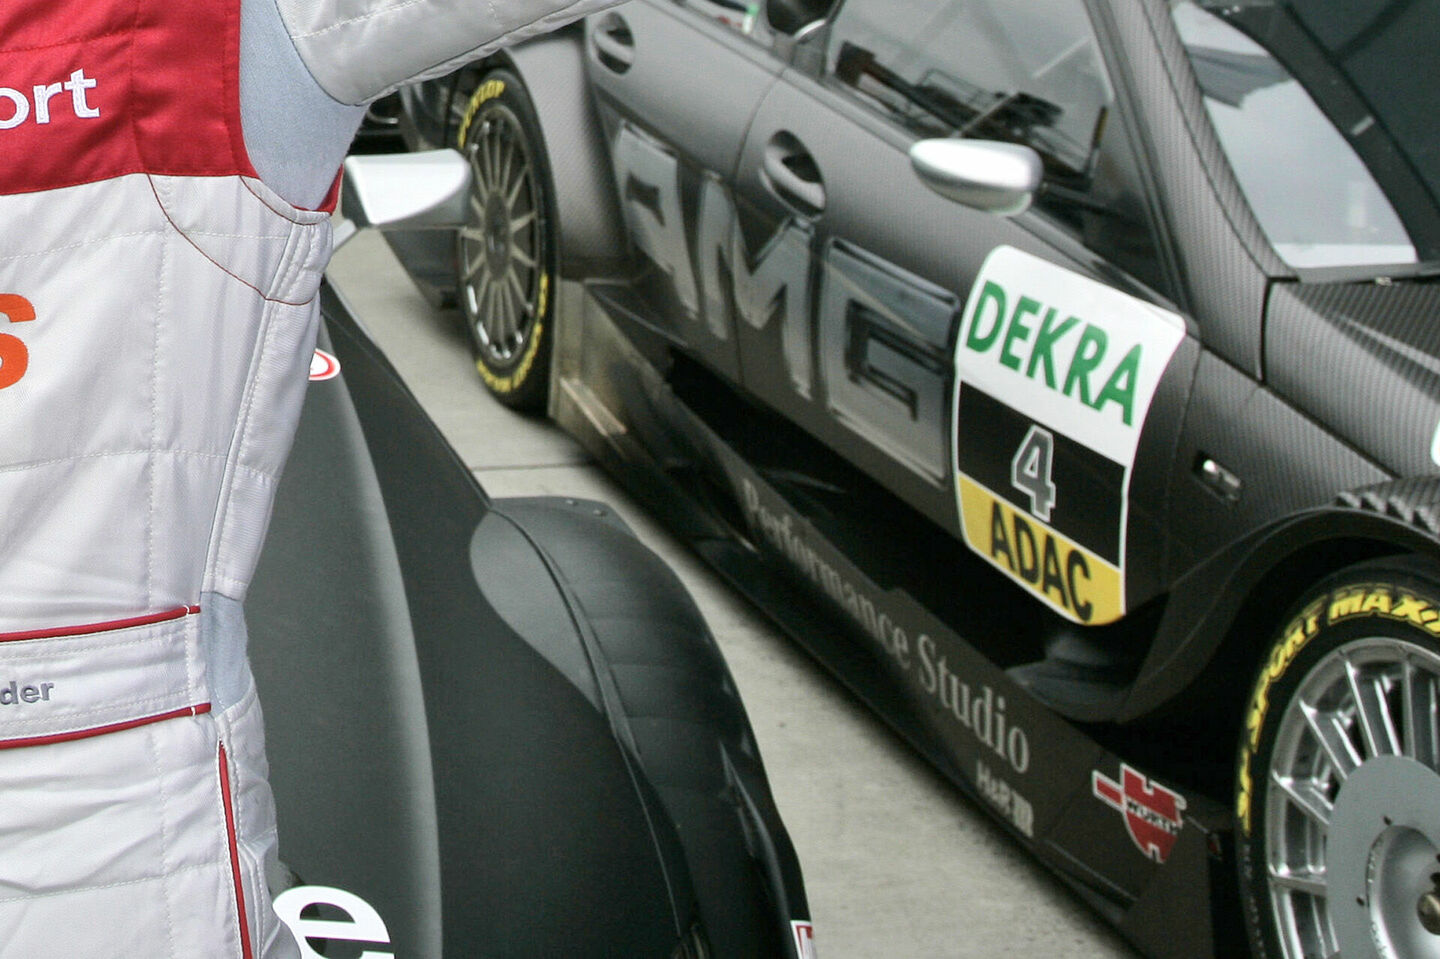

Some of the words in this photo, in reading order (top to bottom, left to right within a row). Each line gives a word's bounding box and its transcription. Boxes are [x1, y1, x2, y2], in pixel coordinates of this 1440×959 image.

[613, 118, 959, 491] AMG
[965, 280, 1143, 428] DEKRA
[1011, 424, 1057, 523] 4
[743, 477, 911, 670] Performance
[917, 633, 1030, 774] Studio
[990, 500, 1093, 623] ADAC
[1247, 614, 1322, 753] SPORT
